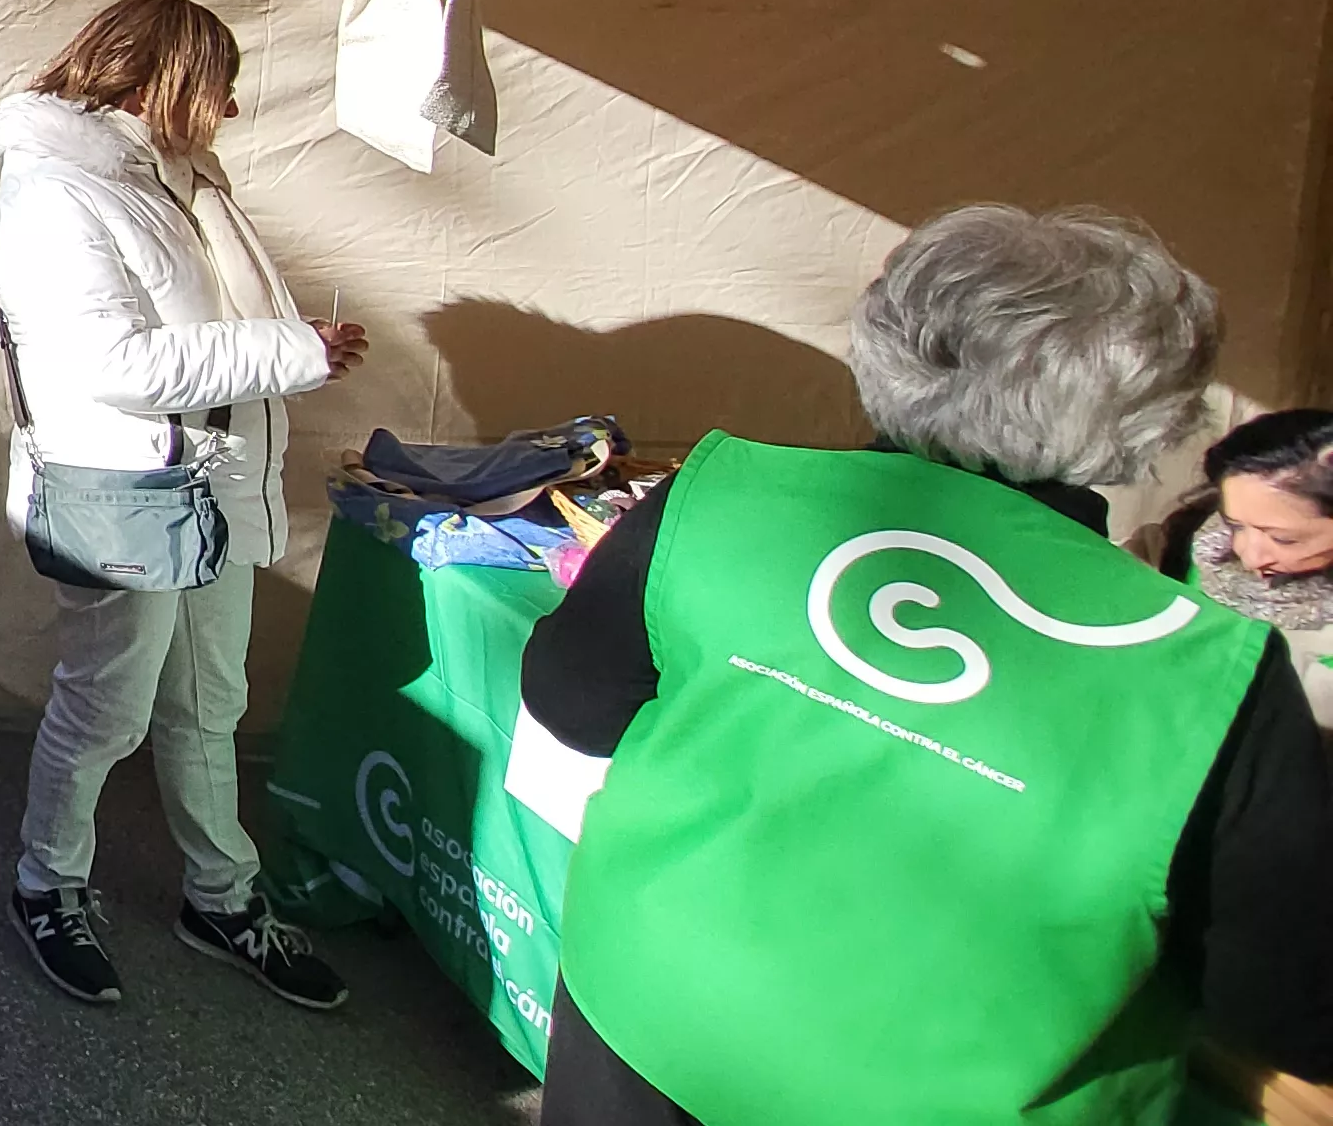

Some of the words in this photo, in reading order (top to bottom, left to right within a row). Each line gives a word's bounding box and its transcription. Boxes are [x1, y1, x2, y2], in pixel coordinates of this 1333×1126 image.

[728, 654, 810, 695] ASOCIACIÓN
[807, 687, 881, 728] ESPAÑOLA
[881, 720, 942, 755] CONTRA
[942, 746, 961, 764] EL
[962, 757, 1026, 793] CÁNCER
